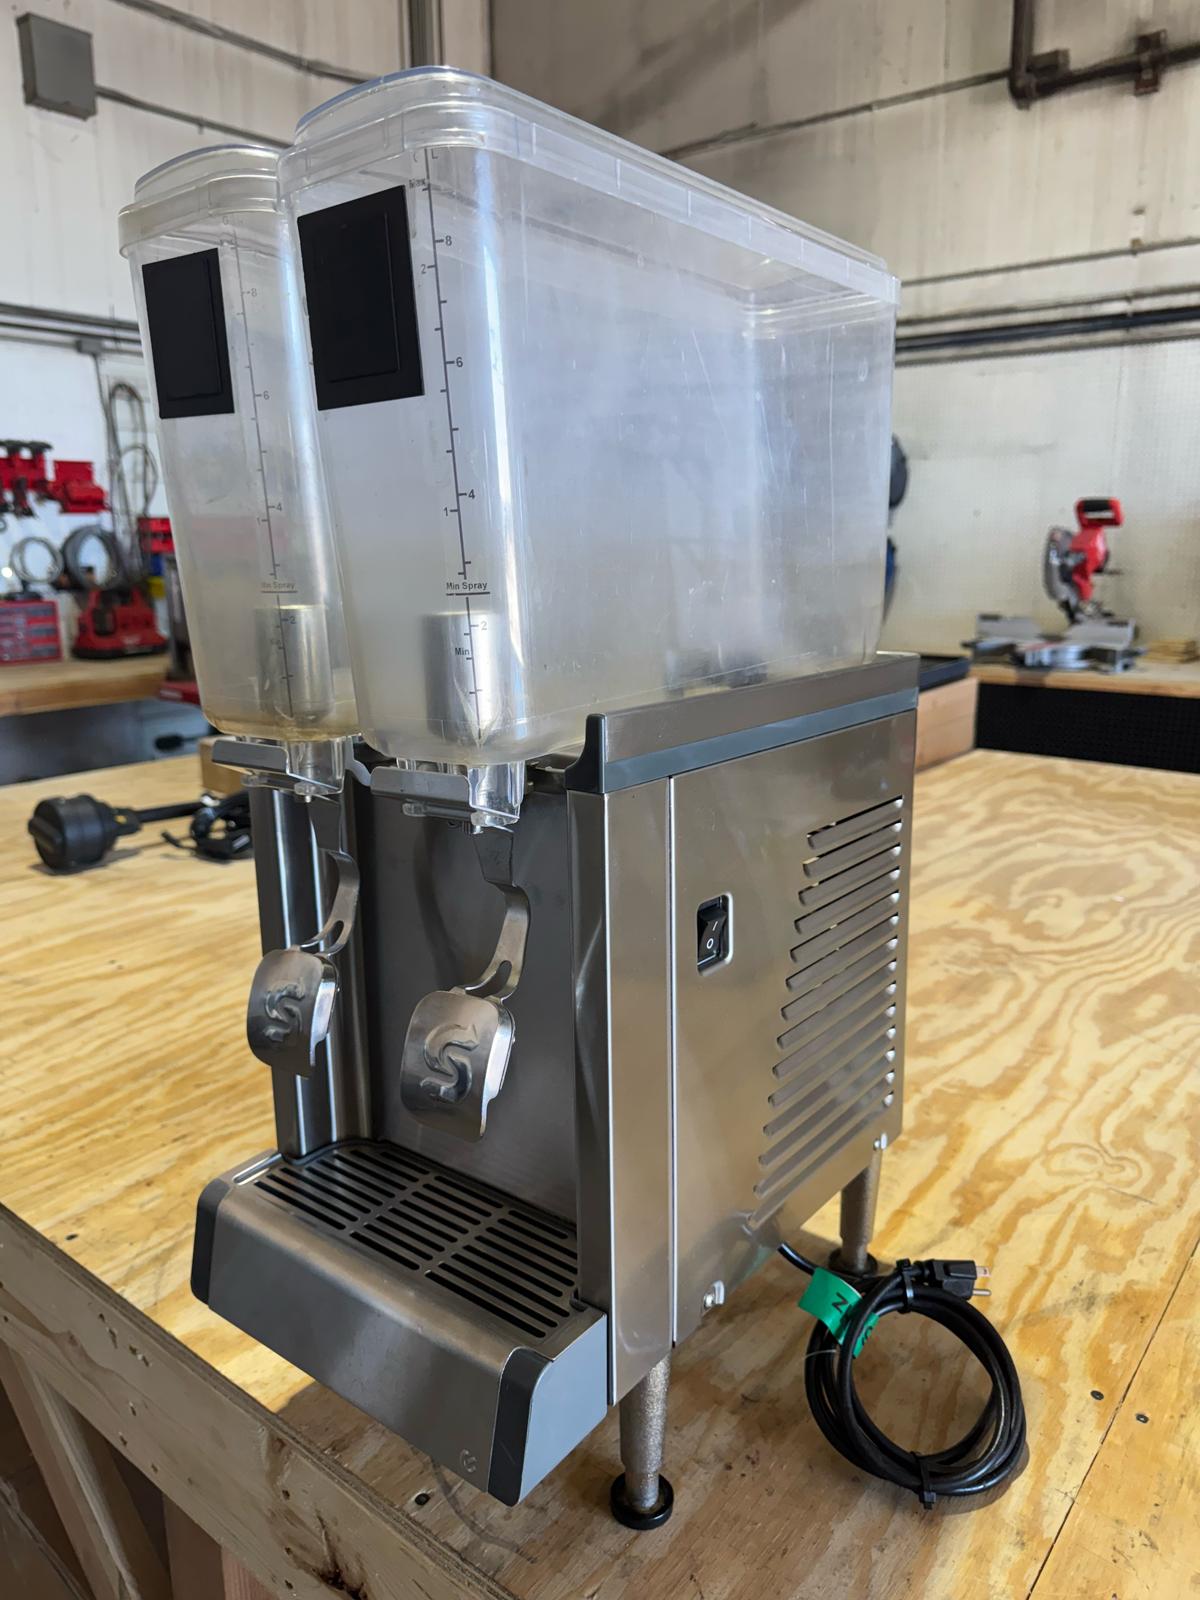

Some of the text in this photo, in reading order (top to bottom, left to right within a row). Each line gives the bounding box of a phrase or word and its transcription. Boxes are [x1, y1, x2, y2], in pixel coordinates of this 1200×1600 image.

[445, 235, 452, 246] 8
[420, 264, 427, 274] 2
[251, 288, 258, 297] 8
[456, 357, 463, 367] 6
[263, 391, 270, 400] 6
[468, 489, 475, 500] 4
[276, 502, 283, 512] 4
[443, 507, 449, 517] 1
[273, 582, 296, 591] Spray
[446, 582, 488, 591] Min Spray
[288, 615, 296, 625] 2
[481, 621, 488, 631] 2
[455, 647, 470, 656] Min
